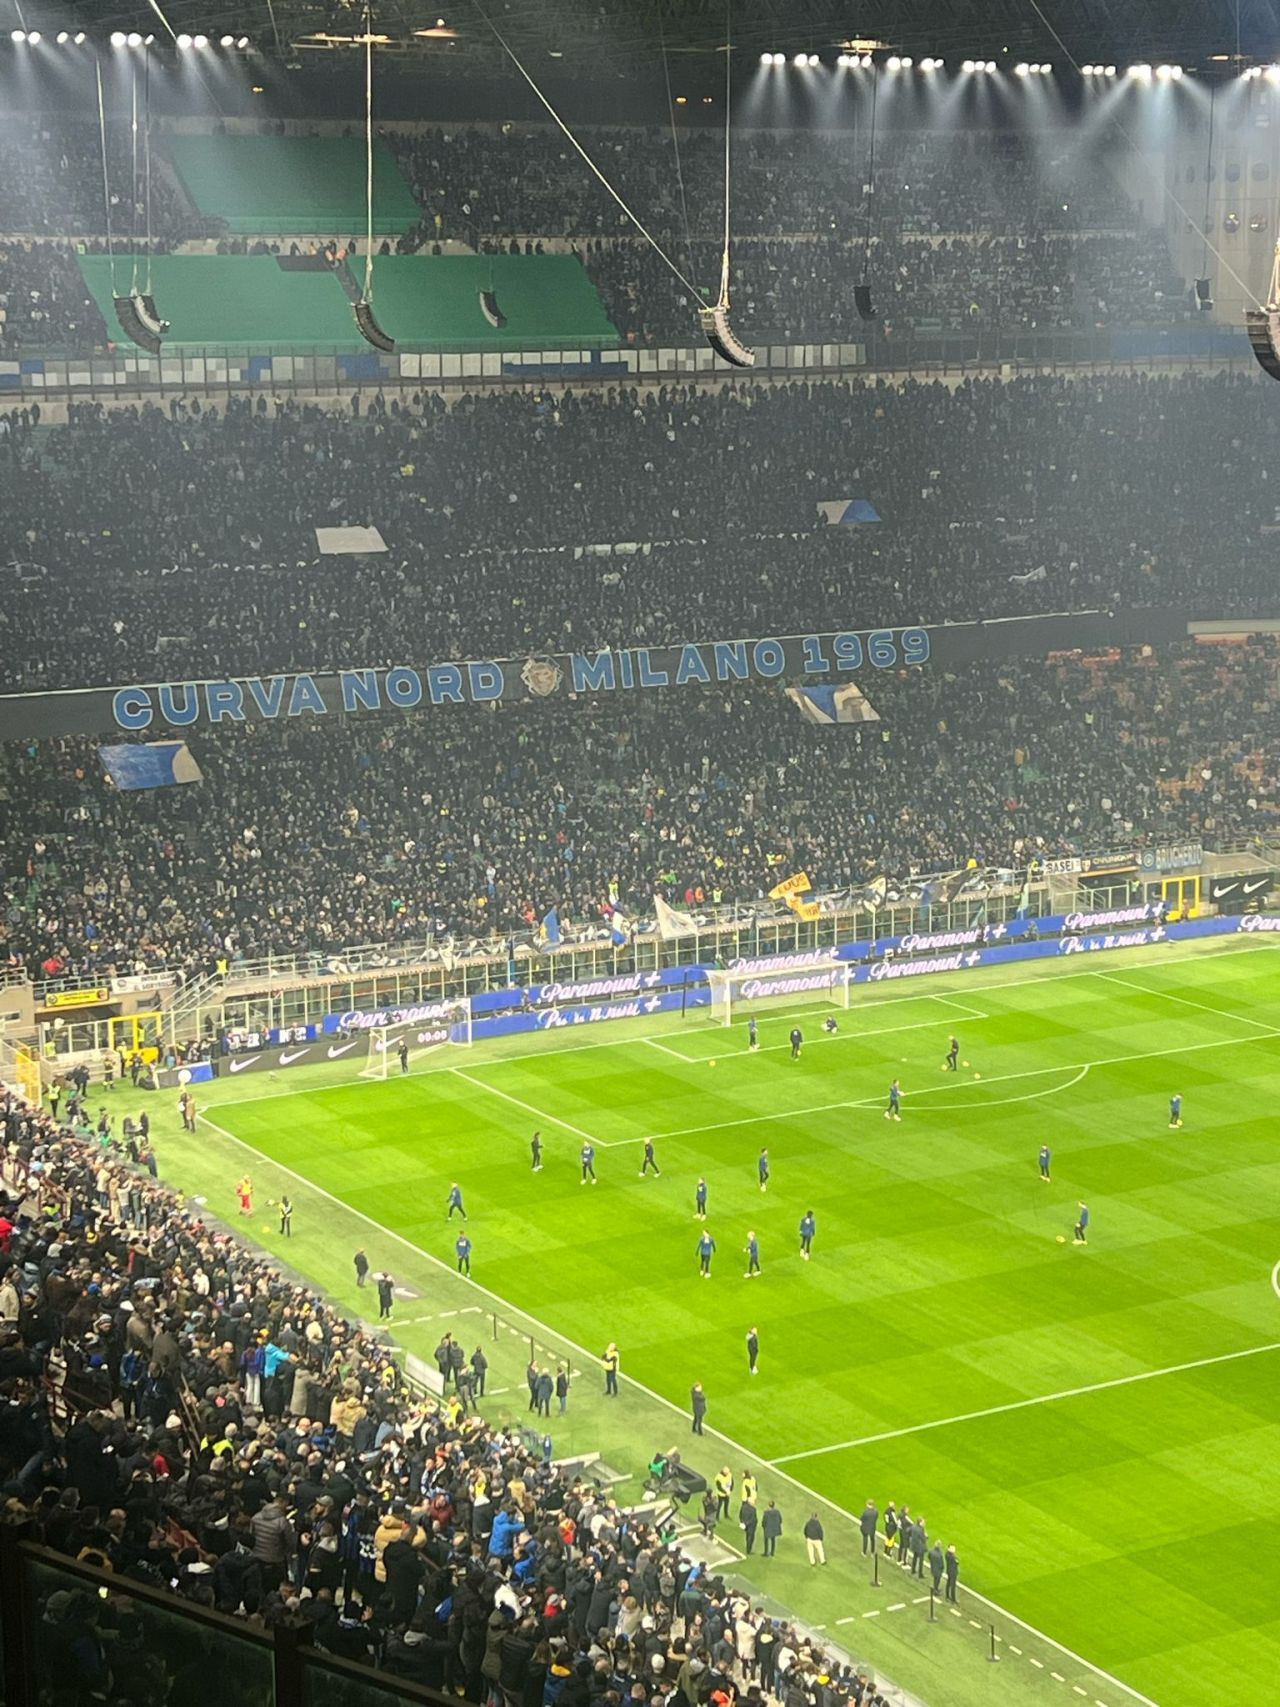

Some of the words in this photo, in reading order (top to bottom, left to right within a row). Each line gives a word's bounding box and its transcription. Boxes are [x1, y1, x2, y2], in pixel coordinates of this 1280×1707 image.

[113, 674, 327, 729] CURVA
[341, 661, 504, 711] NORD
[570, 640, 786, 692] MILANO
[803, 628, 930, 673] 1969
[1065, 903, 1149, 930] Paramount
[870, 953, 962, 980] Paramount
[541, 973, 641, 1002] Paramount
[741, 971, 837, 998] Paramount
